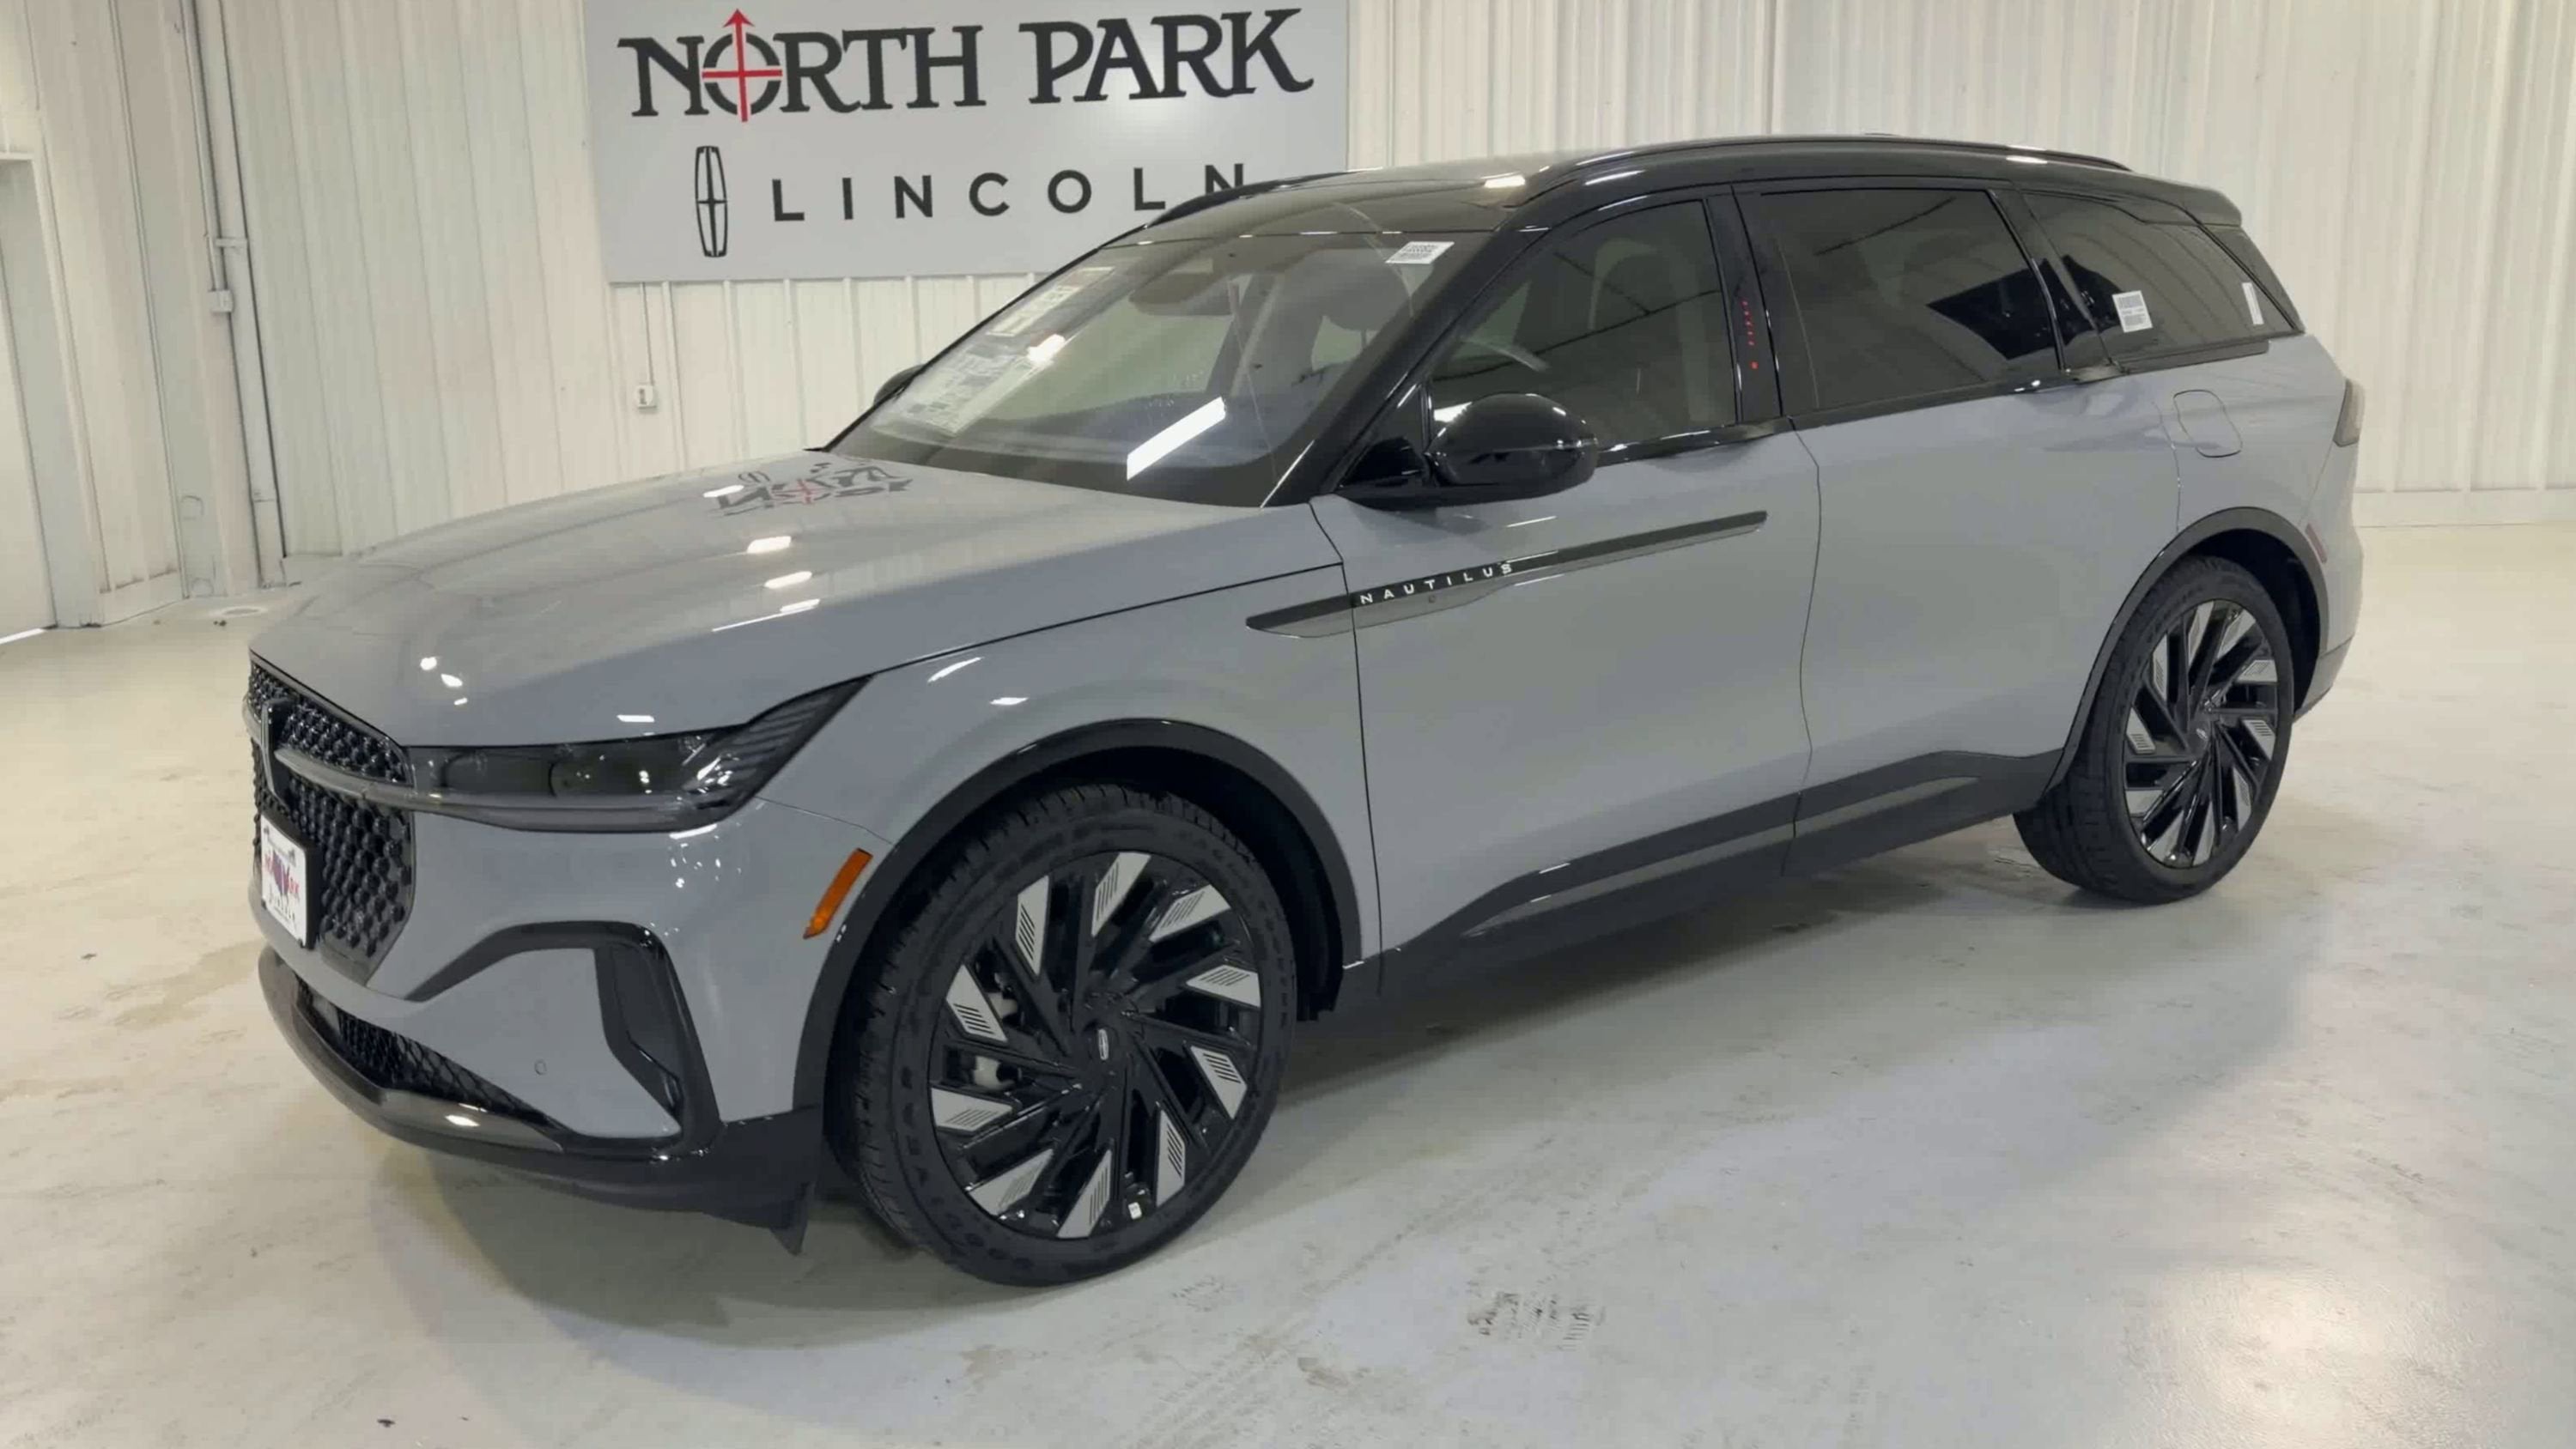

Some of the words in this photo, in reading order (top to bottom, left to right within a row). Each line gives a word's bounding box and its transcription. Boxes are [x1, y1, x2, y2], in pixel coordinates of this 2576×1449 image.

[617, 25, 987, 118] NORTH
[1019, 8, 1315, 104] PARK
[773, 162, 1244, 222] LINCOLN
[1360, 563, 1512, 604] NAUTILUS
